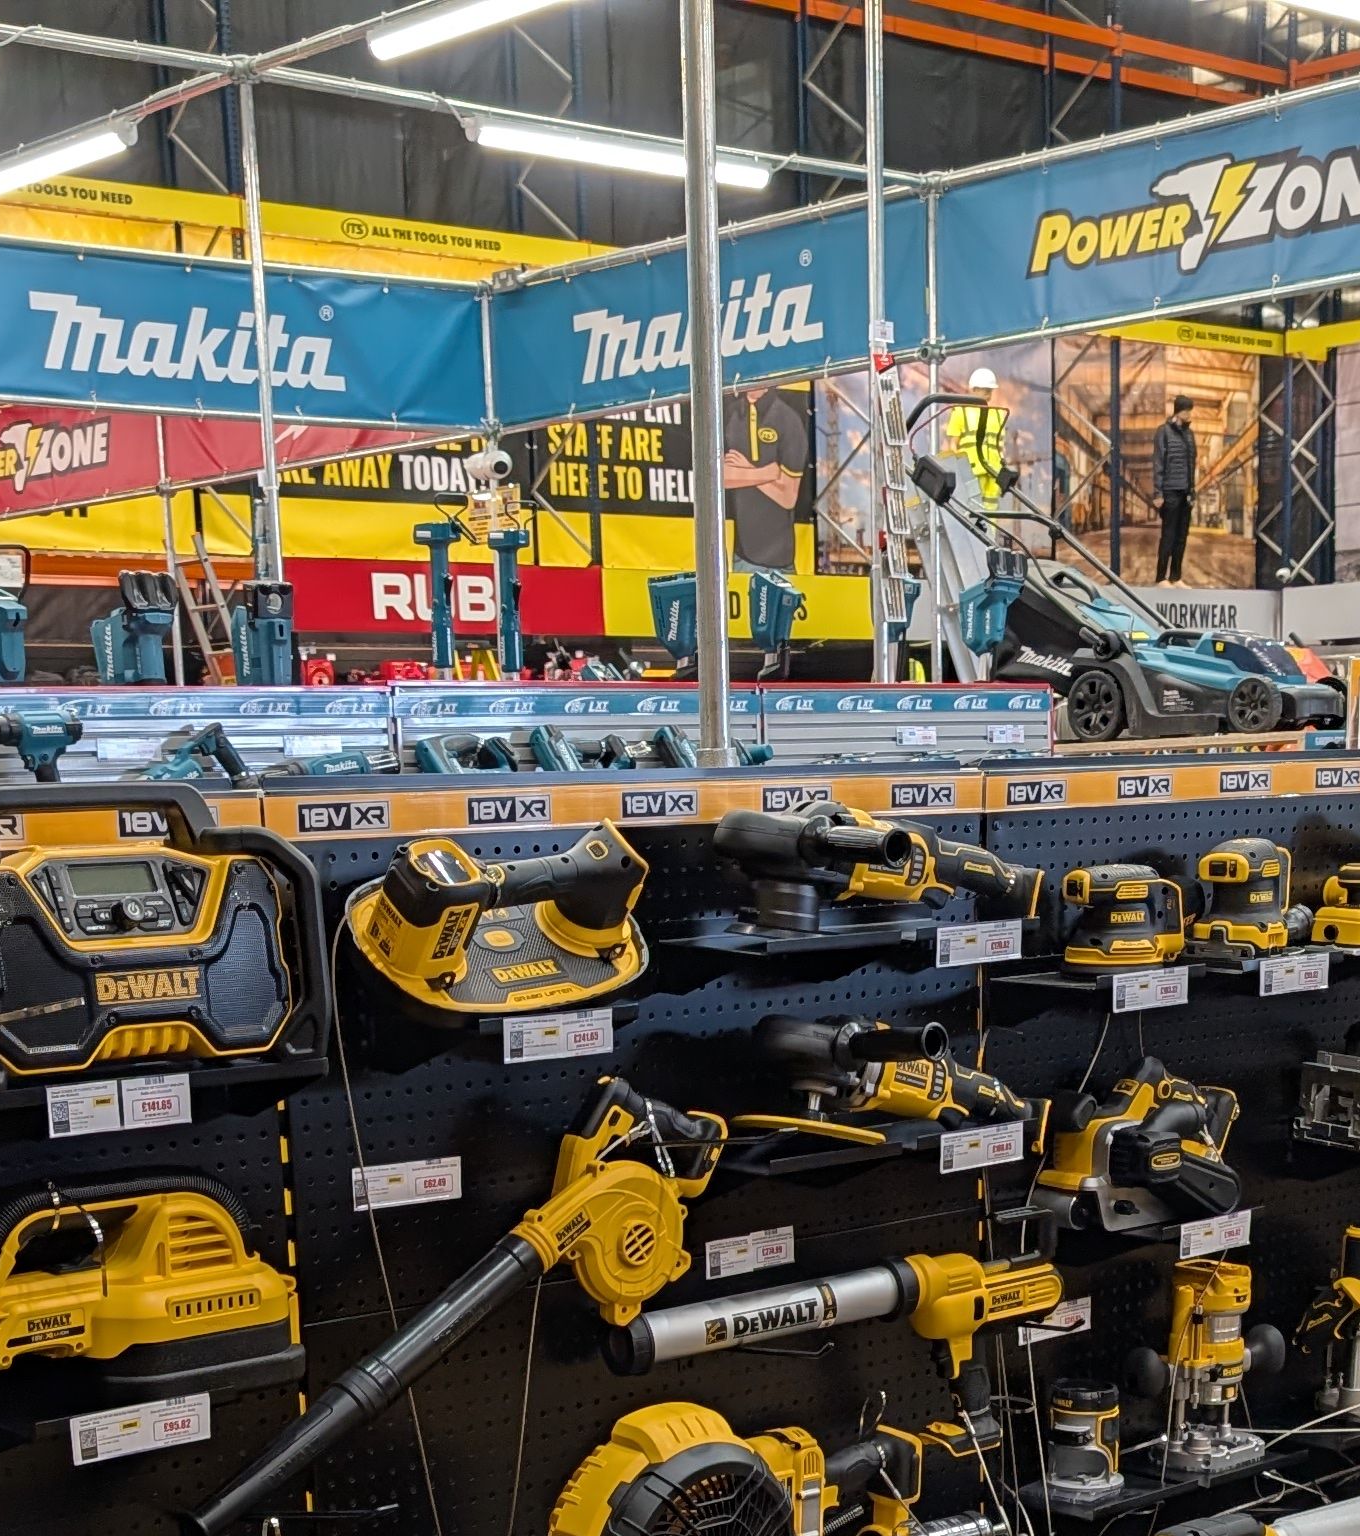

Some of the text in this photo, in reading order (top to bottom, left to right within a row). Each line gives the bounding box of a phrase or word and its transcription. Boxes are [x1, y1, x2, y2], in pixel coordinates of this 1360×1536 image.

[70, 186, 97, 202] YOU
[100, 189, 134, 205] NEED
[372, 225, 502, 252] ALL THE TOOLS YOU NEED
[1031, 206, 1191, 274] POWER
[38, 421, 109, 473] ZONE
[618, 428, 664, 463] ARE
[323, 453, 392, 488] AWAY
[614, 465, 643, 500] TO
[1156, 601, 1238, 631] WORKWEAR
[1118, 777, 1146, 797] 18V
[1221, 772, 1246, 791] 18V
[1316, 769, 1339, 788] 18V
[623, 793, 662, 817] 18V
[893, 784, 929, 806] 18V
[1007, 783, 1041, 803] 18V
[300, 805, 348, 832] 18V
[471, 799, 515, 824] 18V
